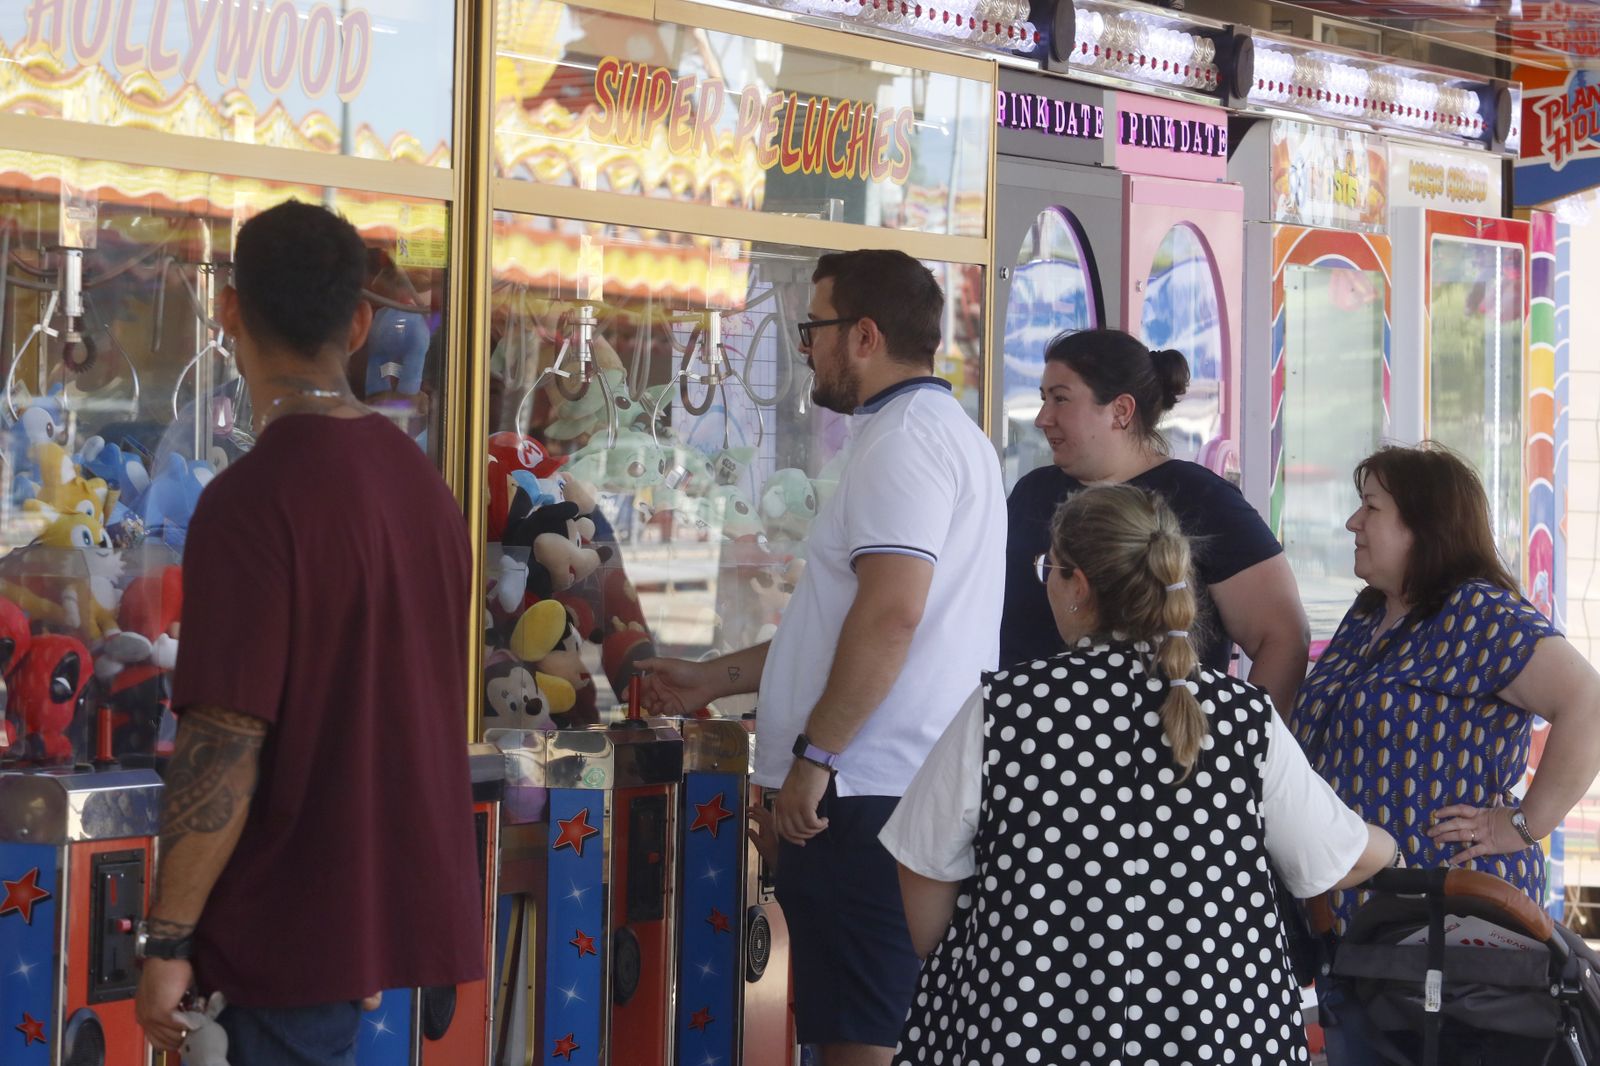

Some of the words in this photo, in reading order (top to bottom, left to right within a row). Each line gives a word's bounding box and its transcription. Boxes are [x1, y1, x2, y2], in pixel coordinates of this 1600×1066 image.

[25, 0, 372, 102] HOLLYWOOD
[588, 55, 726, 157] SUPER
[733, 84, 915, 185] PELUCHES
[997, 90, 1048, 130] PINK
[1054, 100, 1104, 138] DATE
[1128, 112, 1176, 148] PINK
[1180, 120, 1228, 156] DATE
